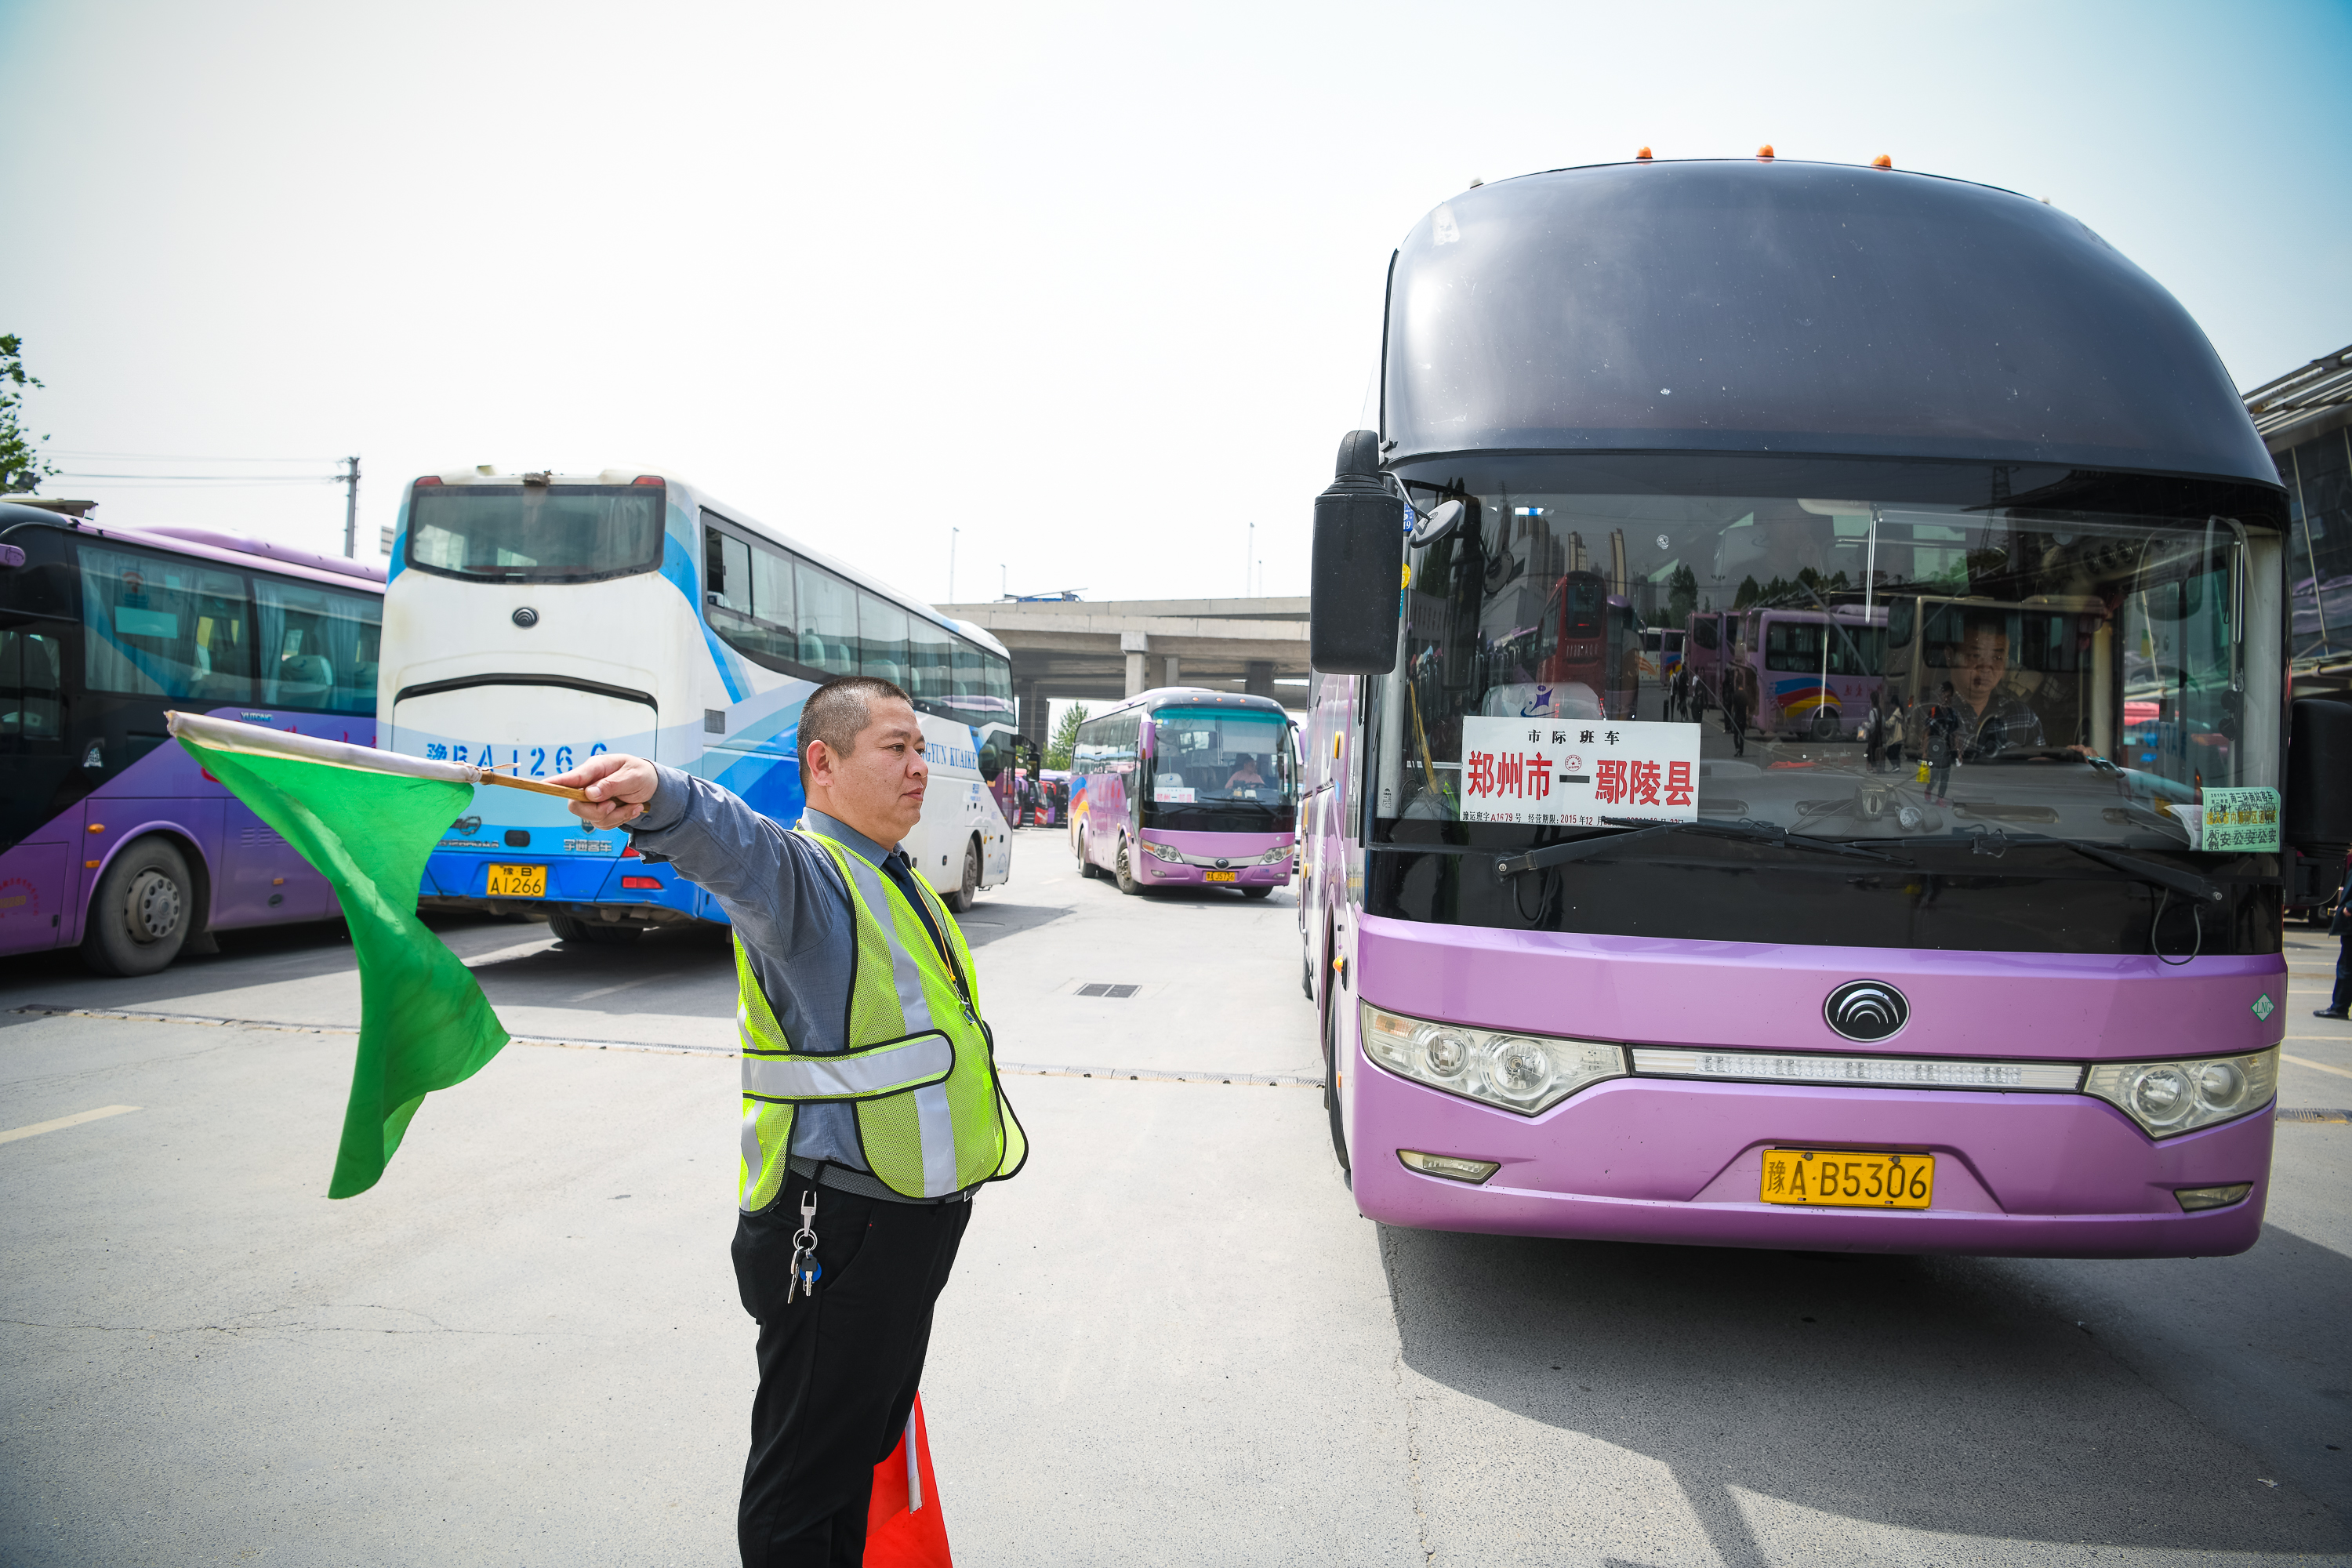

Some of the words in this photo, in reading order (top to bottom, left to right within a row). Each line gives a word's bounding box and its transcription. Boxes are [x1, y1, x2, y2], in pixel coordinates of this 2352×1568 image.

[240, 711, 273, 723] YUTONG
[1528, 729, 1620, 746] 市际班车
[950, 747, 977, 770] KUAIKE
[564, 839, 612, 852] 宇通客车
[490, 877, 542, 894] A1266
[2256, 1002, 2271, 1014] LNG
